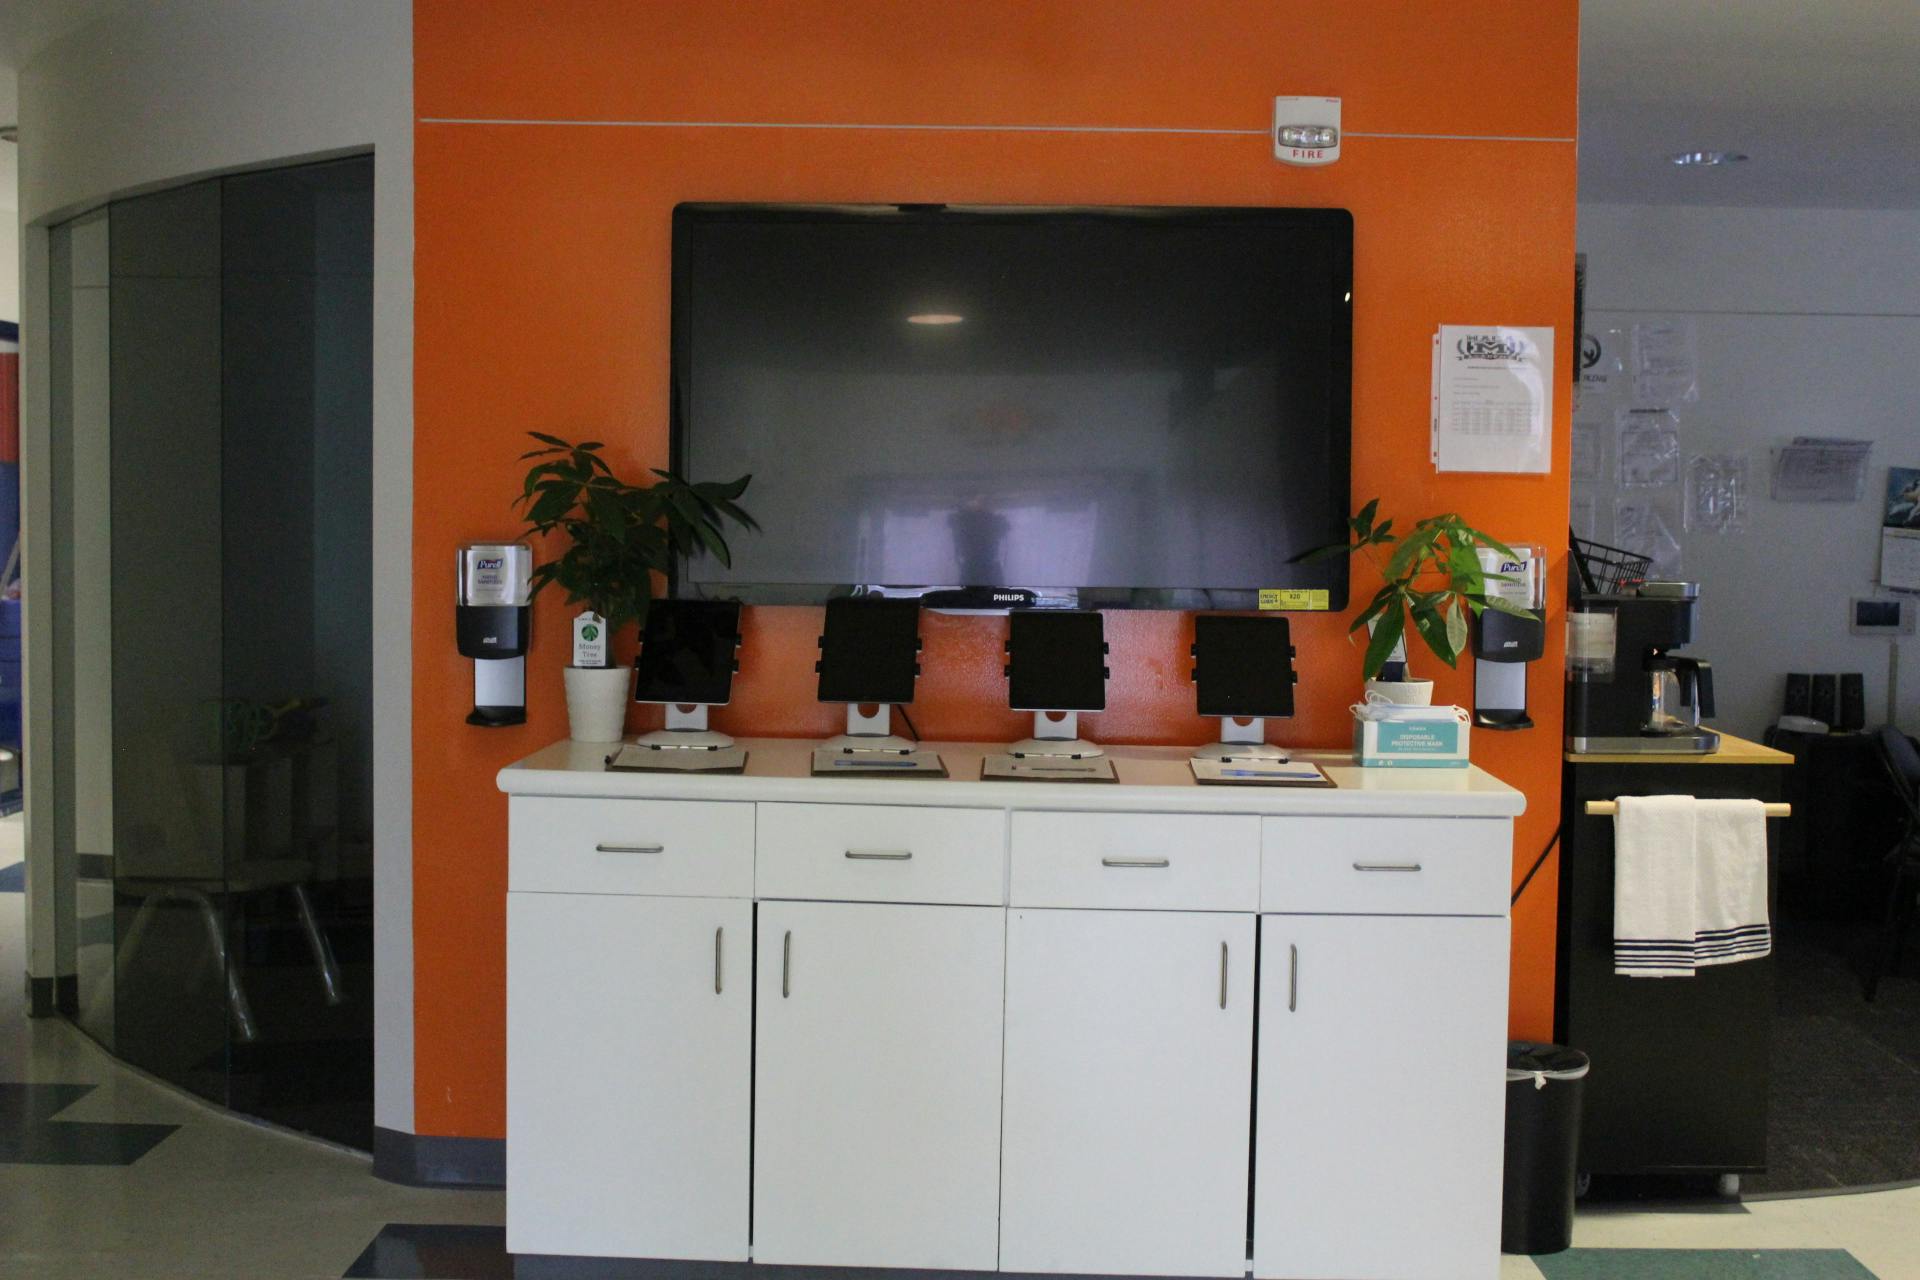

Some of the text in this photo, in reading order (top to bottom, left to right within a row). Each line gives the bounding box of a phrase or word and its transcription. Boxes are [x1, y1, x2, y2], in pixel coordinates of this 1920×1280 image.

[1292, 149, 1325, 159] FIRE
[993, 593, 1025, 602] PHILIPS
[578, 643, 601, 651] Money
